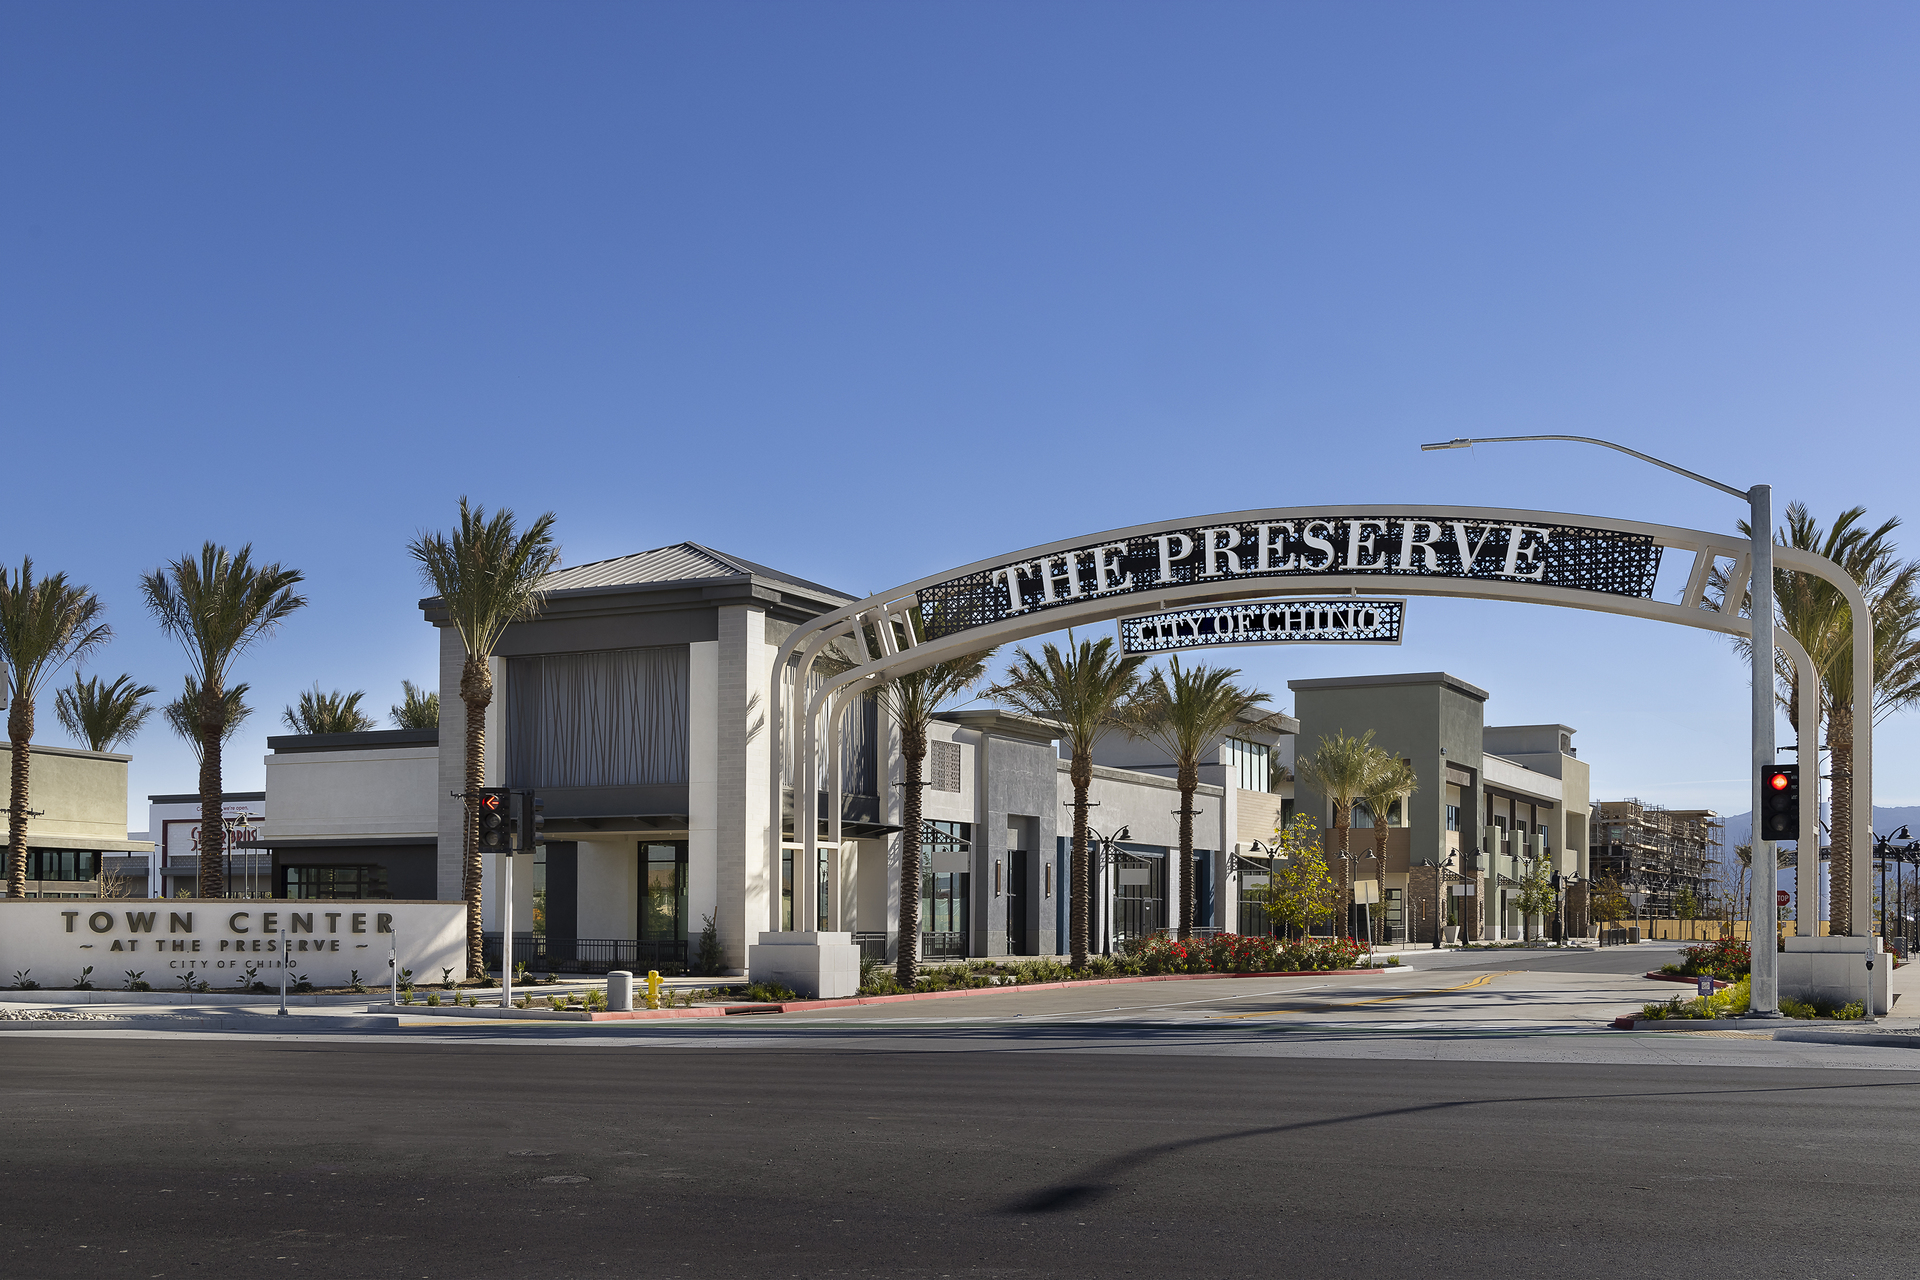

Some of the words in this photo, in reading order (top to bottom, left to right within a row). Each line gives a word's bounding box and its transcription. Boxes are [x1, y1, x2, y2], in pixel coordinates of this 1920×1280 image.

[992, 543, 1132, 614] THE
[1151, 519, 1550, 584] PRESERVE
[1138, 615, 1205, 646] CITY
[1214, 610, 1255, 638] OF
[1263, 607, 1380, 635] CHINO
[61, 911, 193, 934] TOWN
[229, 911, 393, 934] CENTER
[110, 939, 139, 952] AT
[155, 939, 201, 952] THE
[220, 939, 340, 952] PRESERVE
[169, 960, 208, 969] CITY
[217, 960, 236, 969] OF
